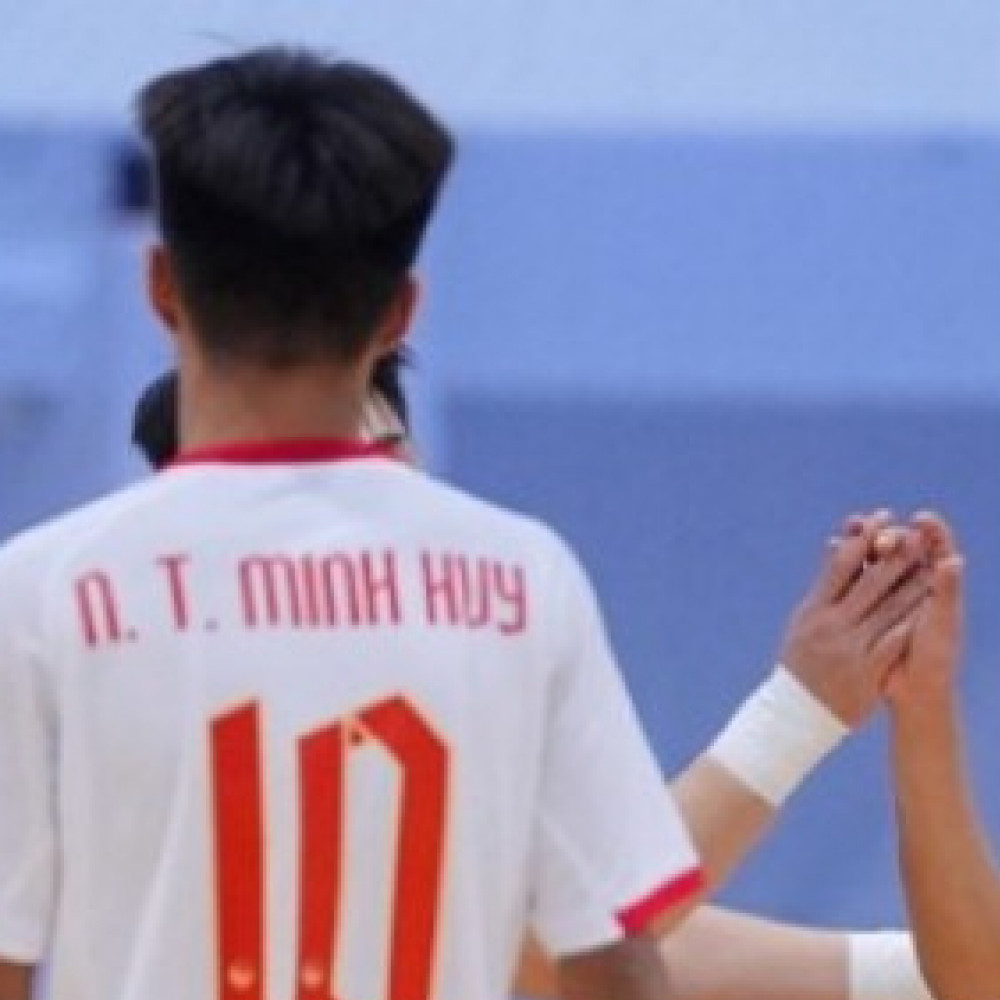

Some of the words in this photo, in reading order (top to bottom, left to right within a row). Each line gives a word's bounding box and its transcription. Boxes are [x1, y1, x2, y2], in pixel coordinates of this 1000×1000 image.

[155, 553, 219, 632] T.
[237, 549, 402, 629] MINH
[420, 550, 527, 636] HUY
